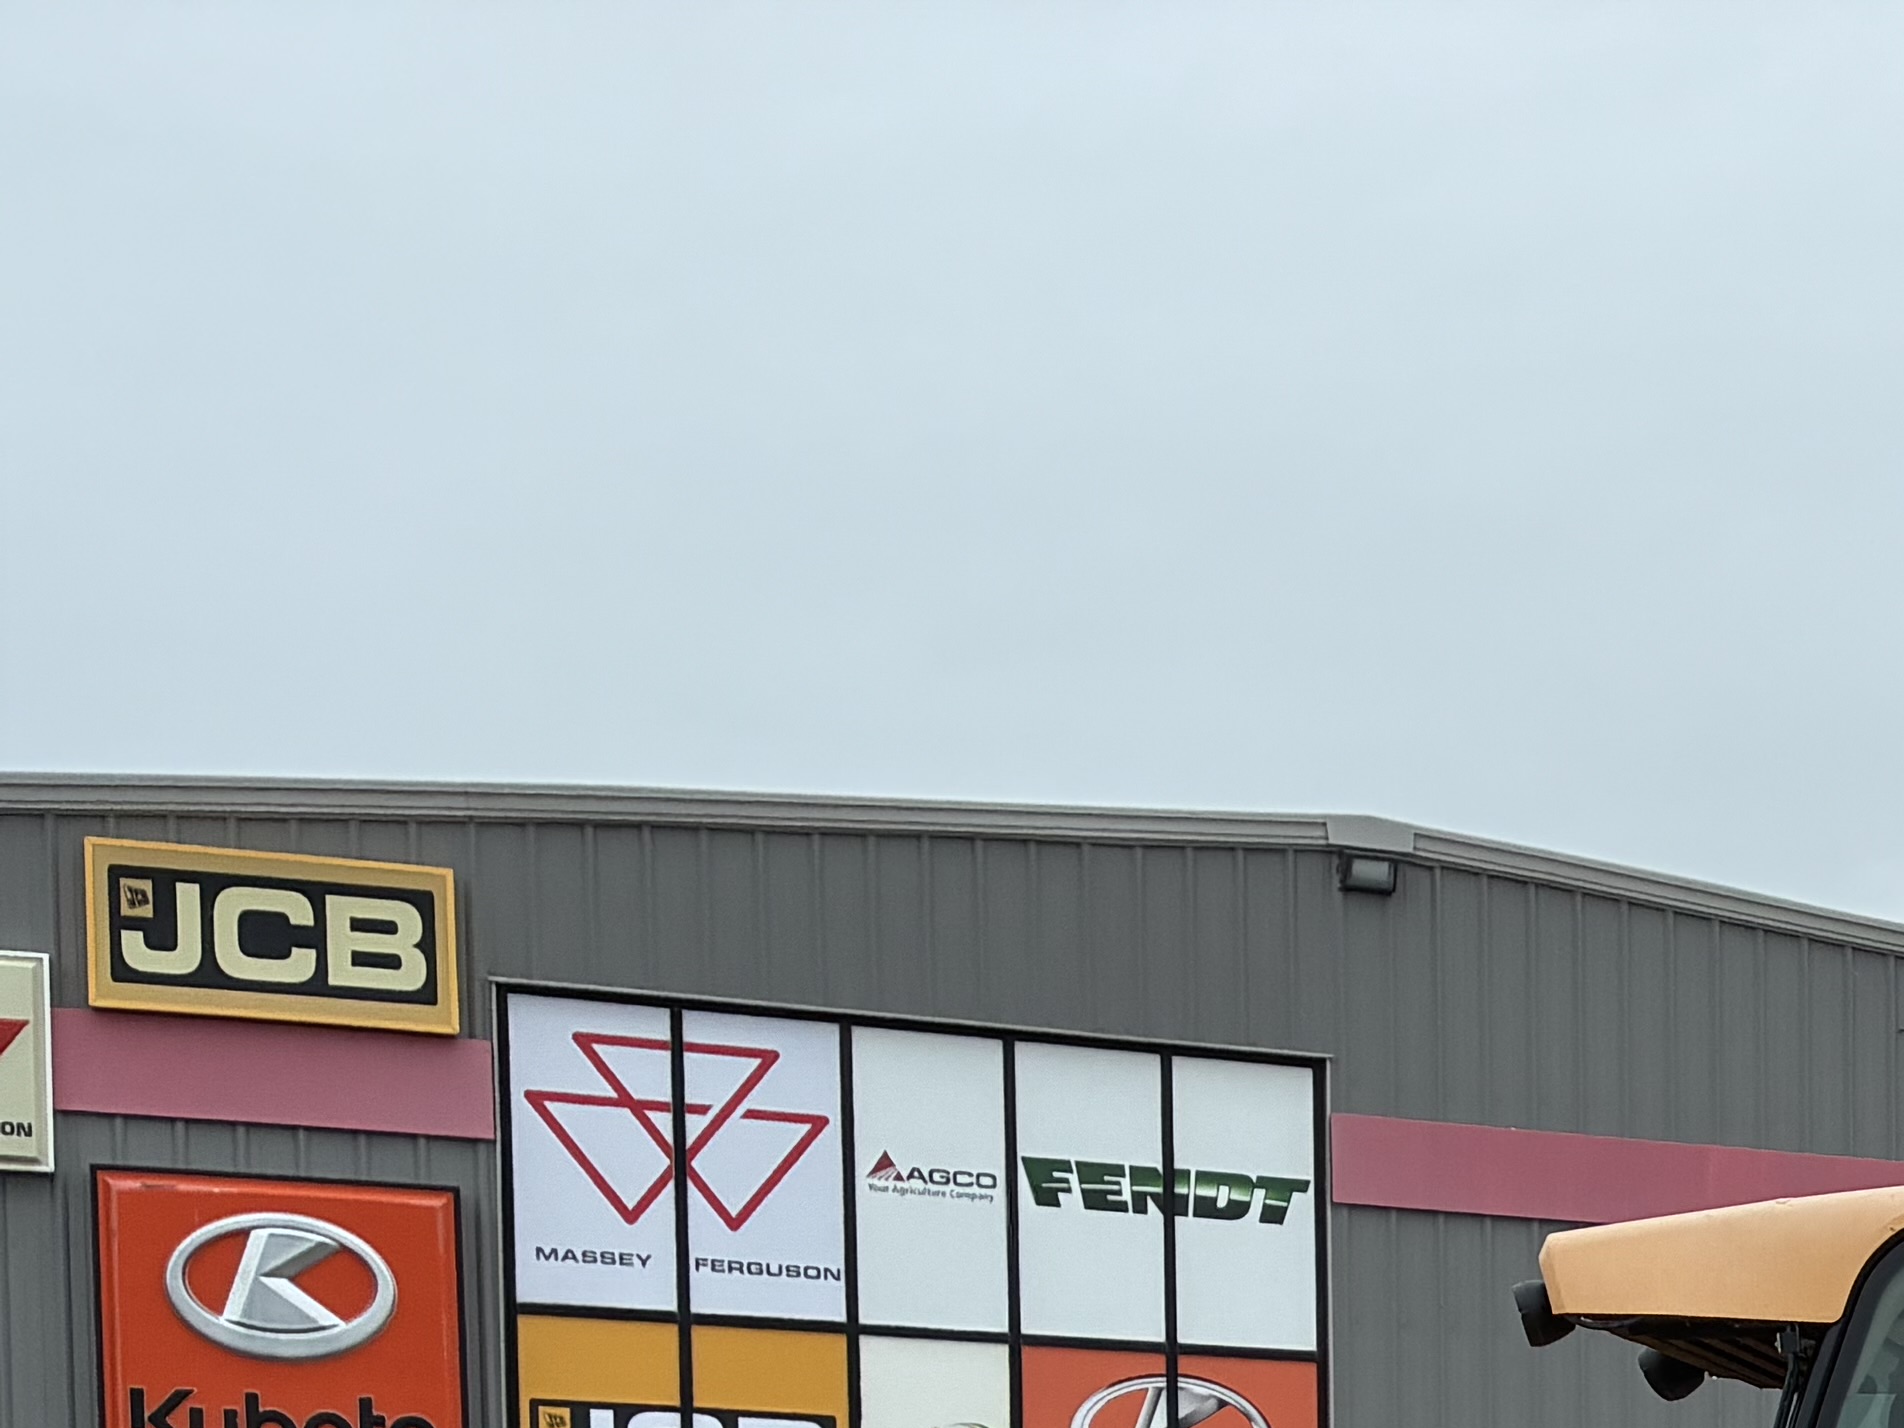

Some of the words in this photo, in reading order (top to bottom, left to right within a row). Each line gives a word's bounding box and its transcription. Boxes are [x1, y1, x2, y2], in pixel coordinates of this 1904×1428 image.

[120, 882, 428, 992] JCB
[891, 1185, 947, 1197] Agriculture
[949, 1189, 994, 1204] Company
[906, 1166, 998, 1189] AGCO
[1021, 1156, 1311, 1225] FENDT
[535, 1246, 652, 1269] MASSEY
[694, 1257, 842, 1282] FERGUSON
